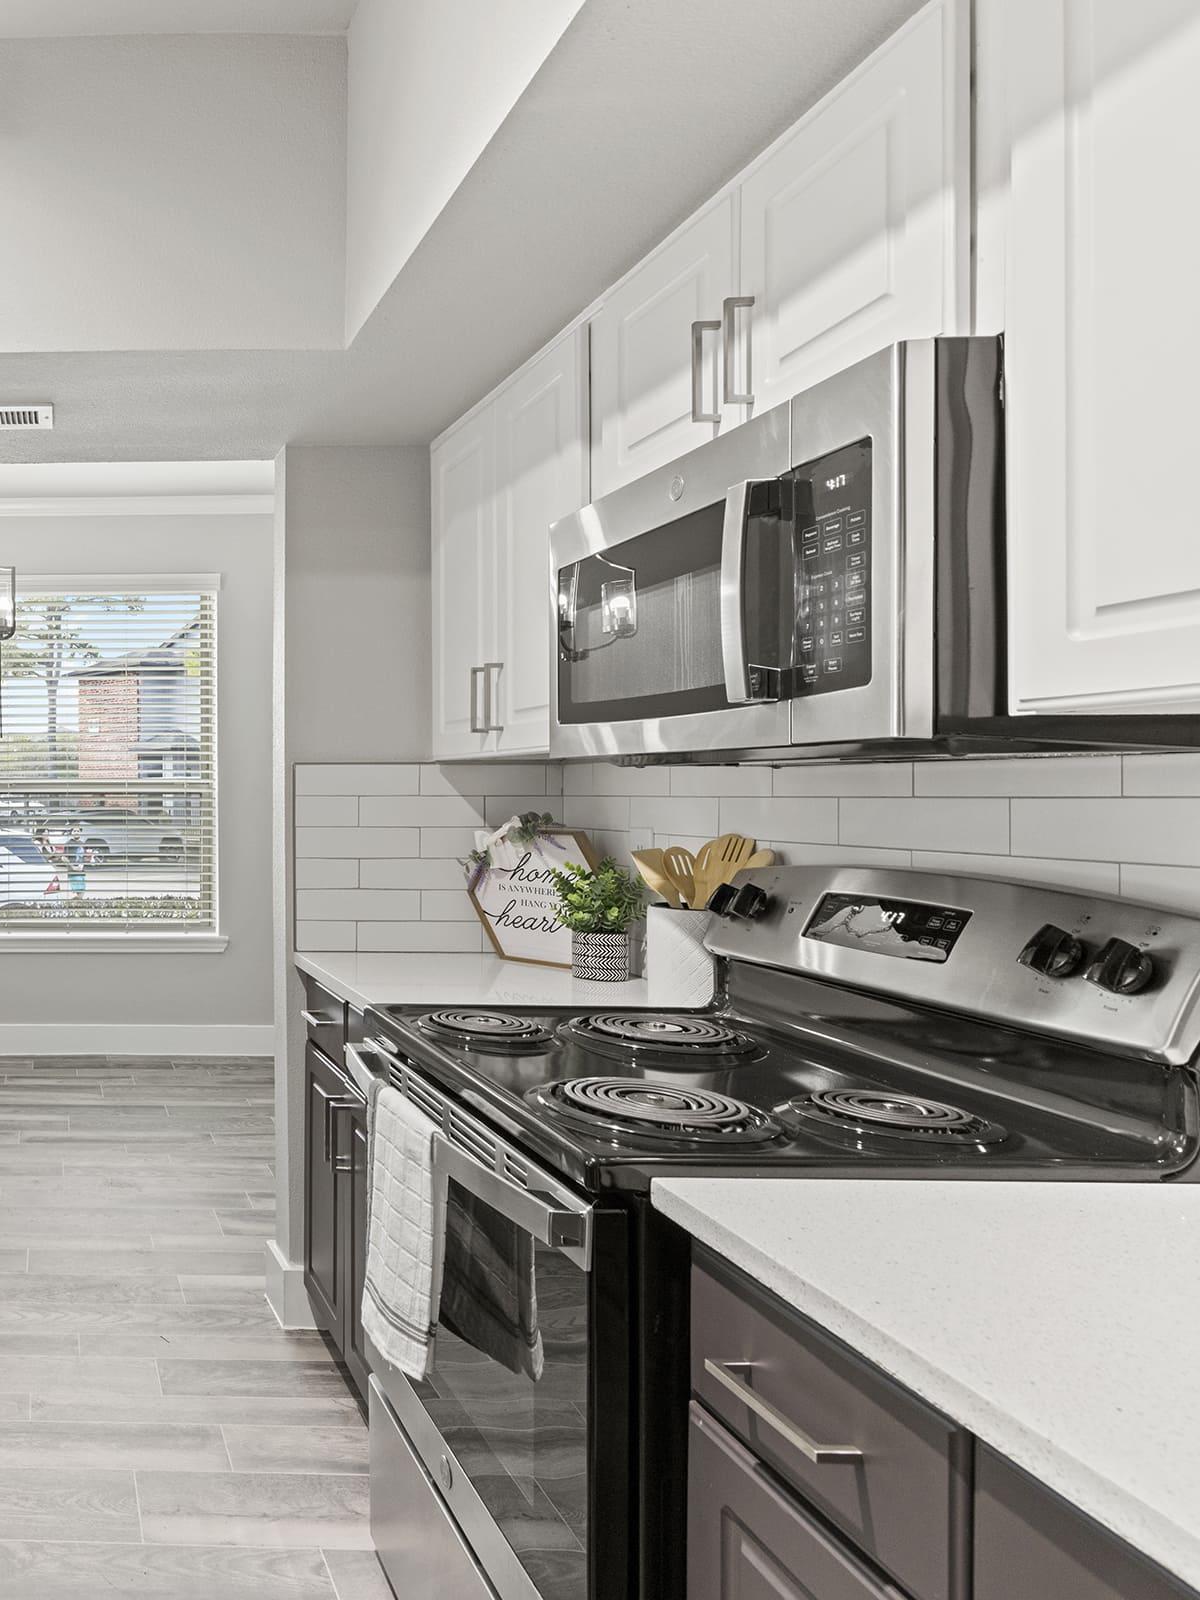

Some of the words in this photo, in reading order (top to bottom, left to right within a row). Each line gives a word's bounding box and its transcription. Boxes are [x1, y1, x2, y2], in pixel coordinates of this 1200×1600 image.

[498, 883, 506, 891] IS
[520, 898, 547, 909] HANG
[483, 899, 564, 933] heart
